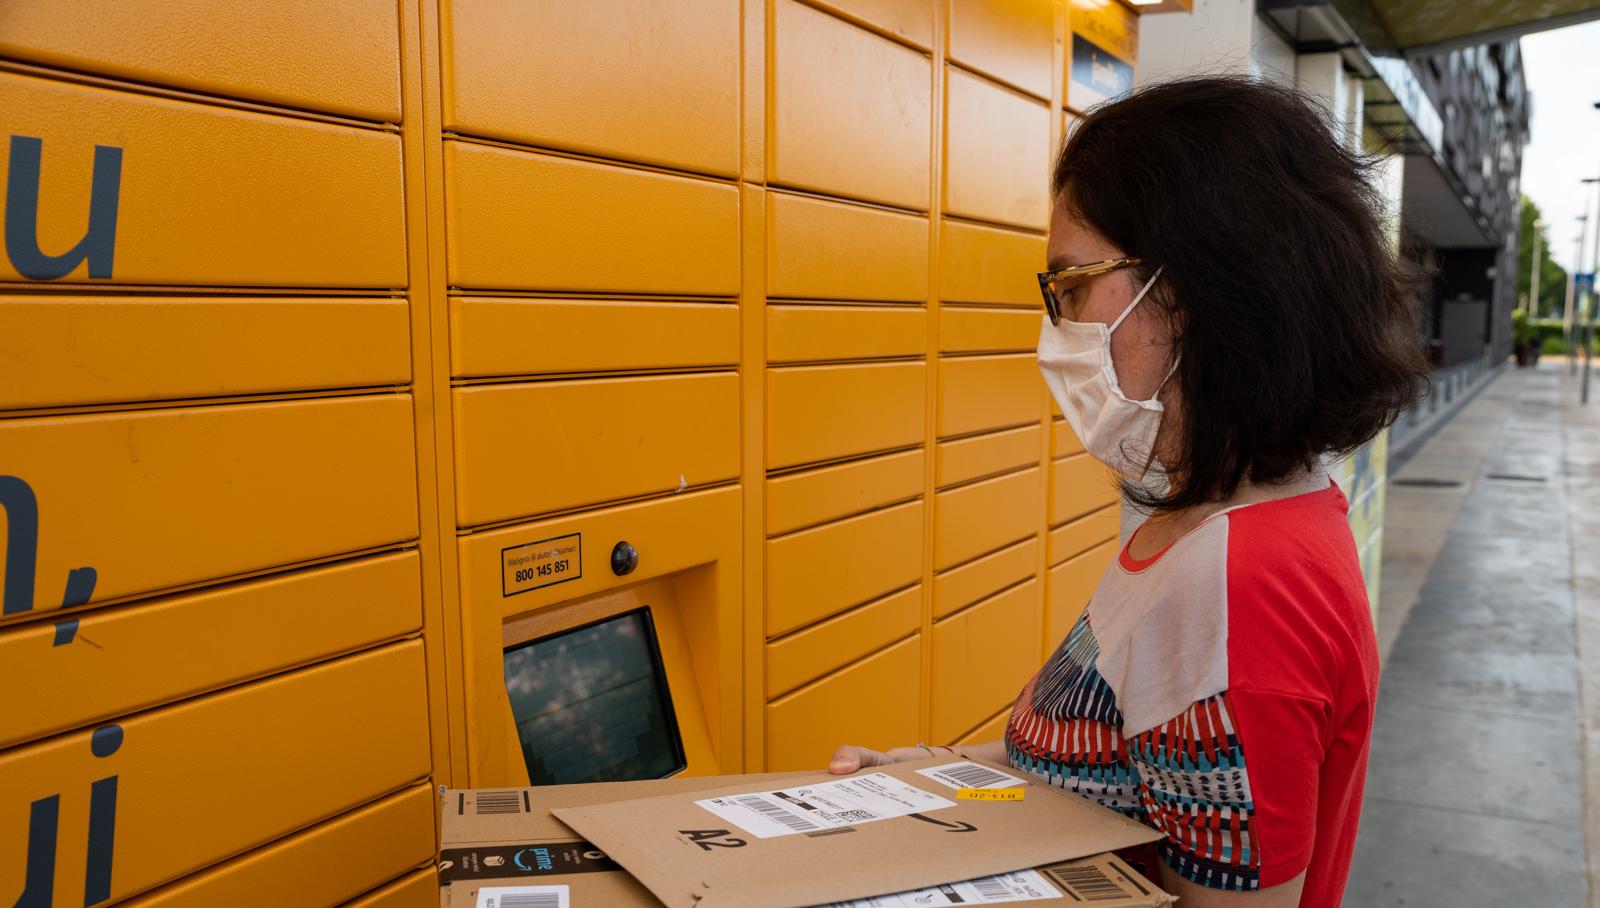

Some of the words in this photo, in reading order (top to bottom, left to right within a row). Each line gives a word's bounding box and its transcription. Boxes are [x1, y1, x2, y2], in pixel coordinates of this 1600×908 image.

[508, 556, 530, 567] Bisogno
[530, 552, 536, 562] di
[515, 568, 534, 582] 800
[536, 562, 552, 577] 145
[554, 559, 569, 573] 851
[678, 829, 748, 851] A2
[529, 847, 554, 870] prime
